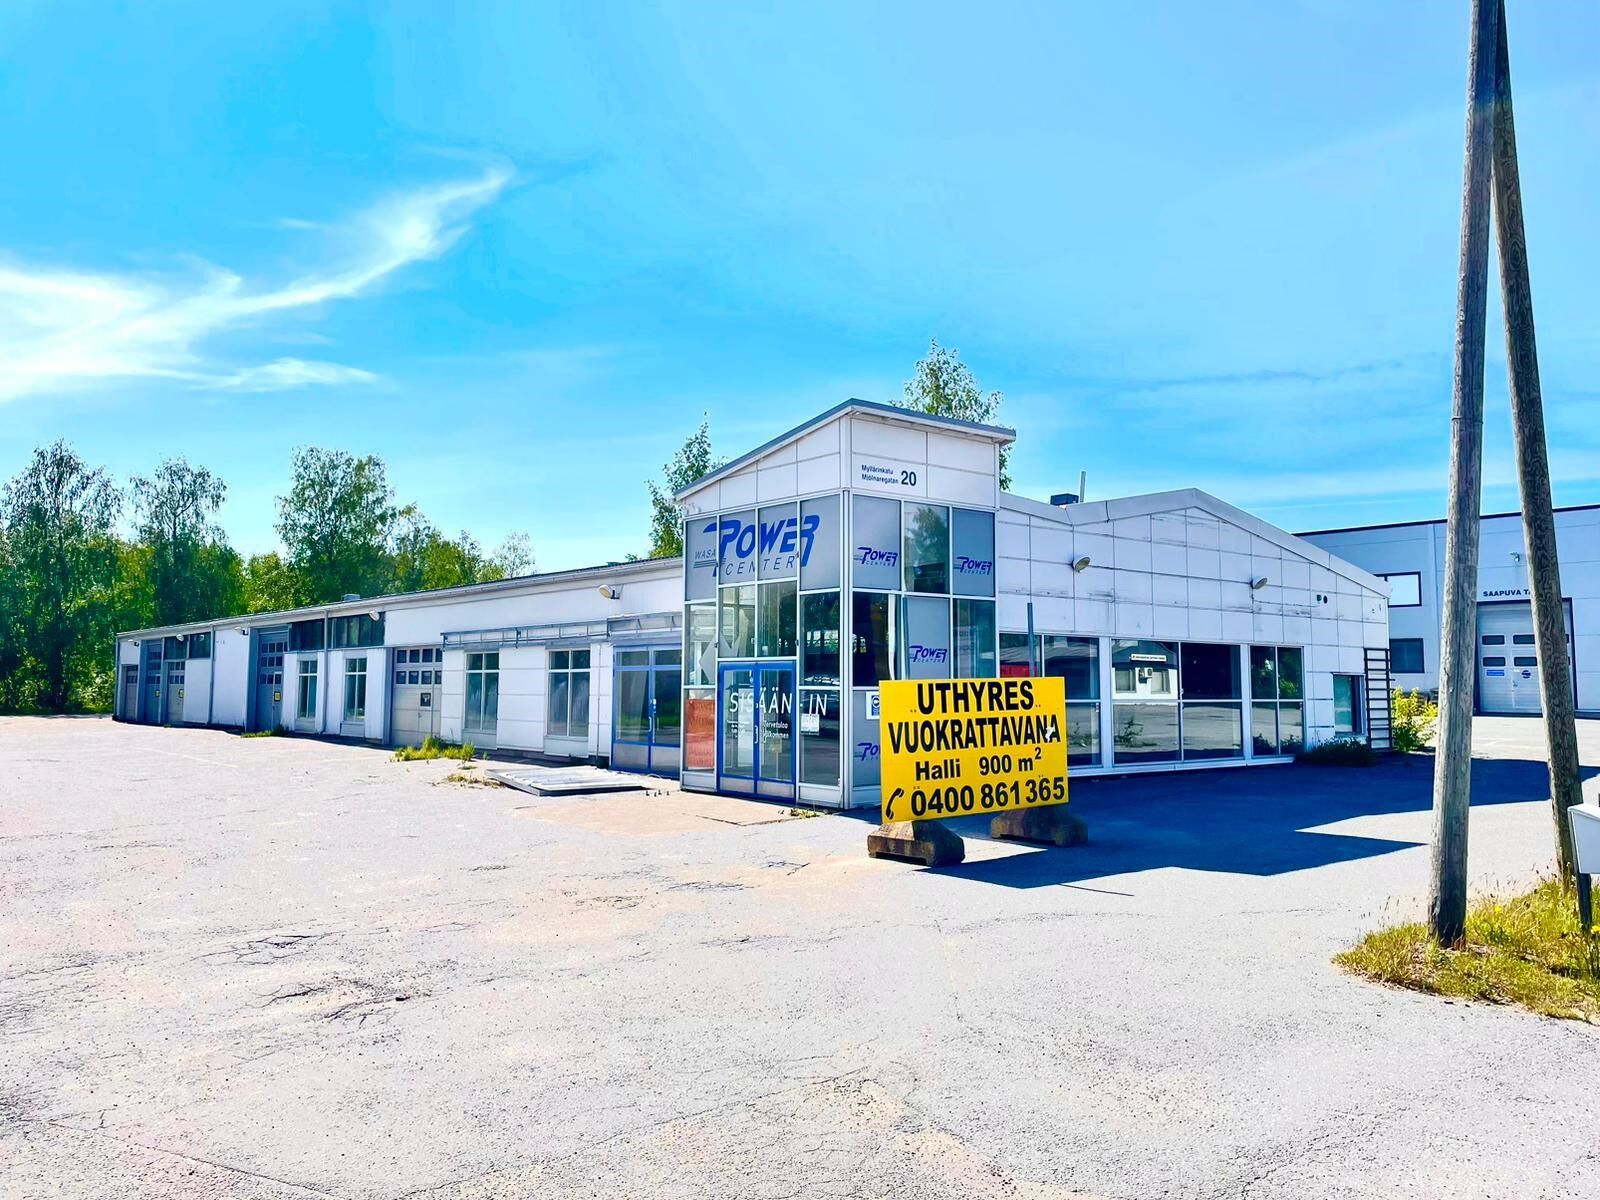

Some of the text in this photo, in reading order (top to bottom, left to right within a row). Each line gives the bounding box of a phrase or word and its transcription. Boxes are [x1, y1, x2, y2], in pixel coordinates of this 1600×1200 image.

[901, 470, 917, 487] 20
[694, 548, 717, 560] WASA
[702, 514, 820, 578] POWER
[857, 546, 898, 567] POWER
[725, 555, 796, 576] CENTER
[956, 556, 992, 575] POWER
[1482, 589, 1522, 597] SAAPUVA
[909, 645, 947, 663] POWER
[729, 686, 828, 716] SISÄÄN IN
[917, 680, 1034, 715] UTHYRES
[888, 714, 1061, 754] VUOKRATTAVANA
[915, 758, 961, 781] Halli
[979, 754, 1012, 776] 900
[911, 776, 1065, 816] 0400 861 365
